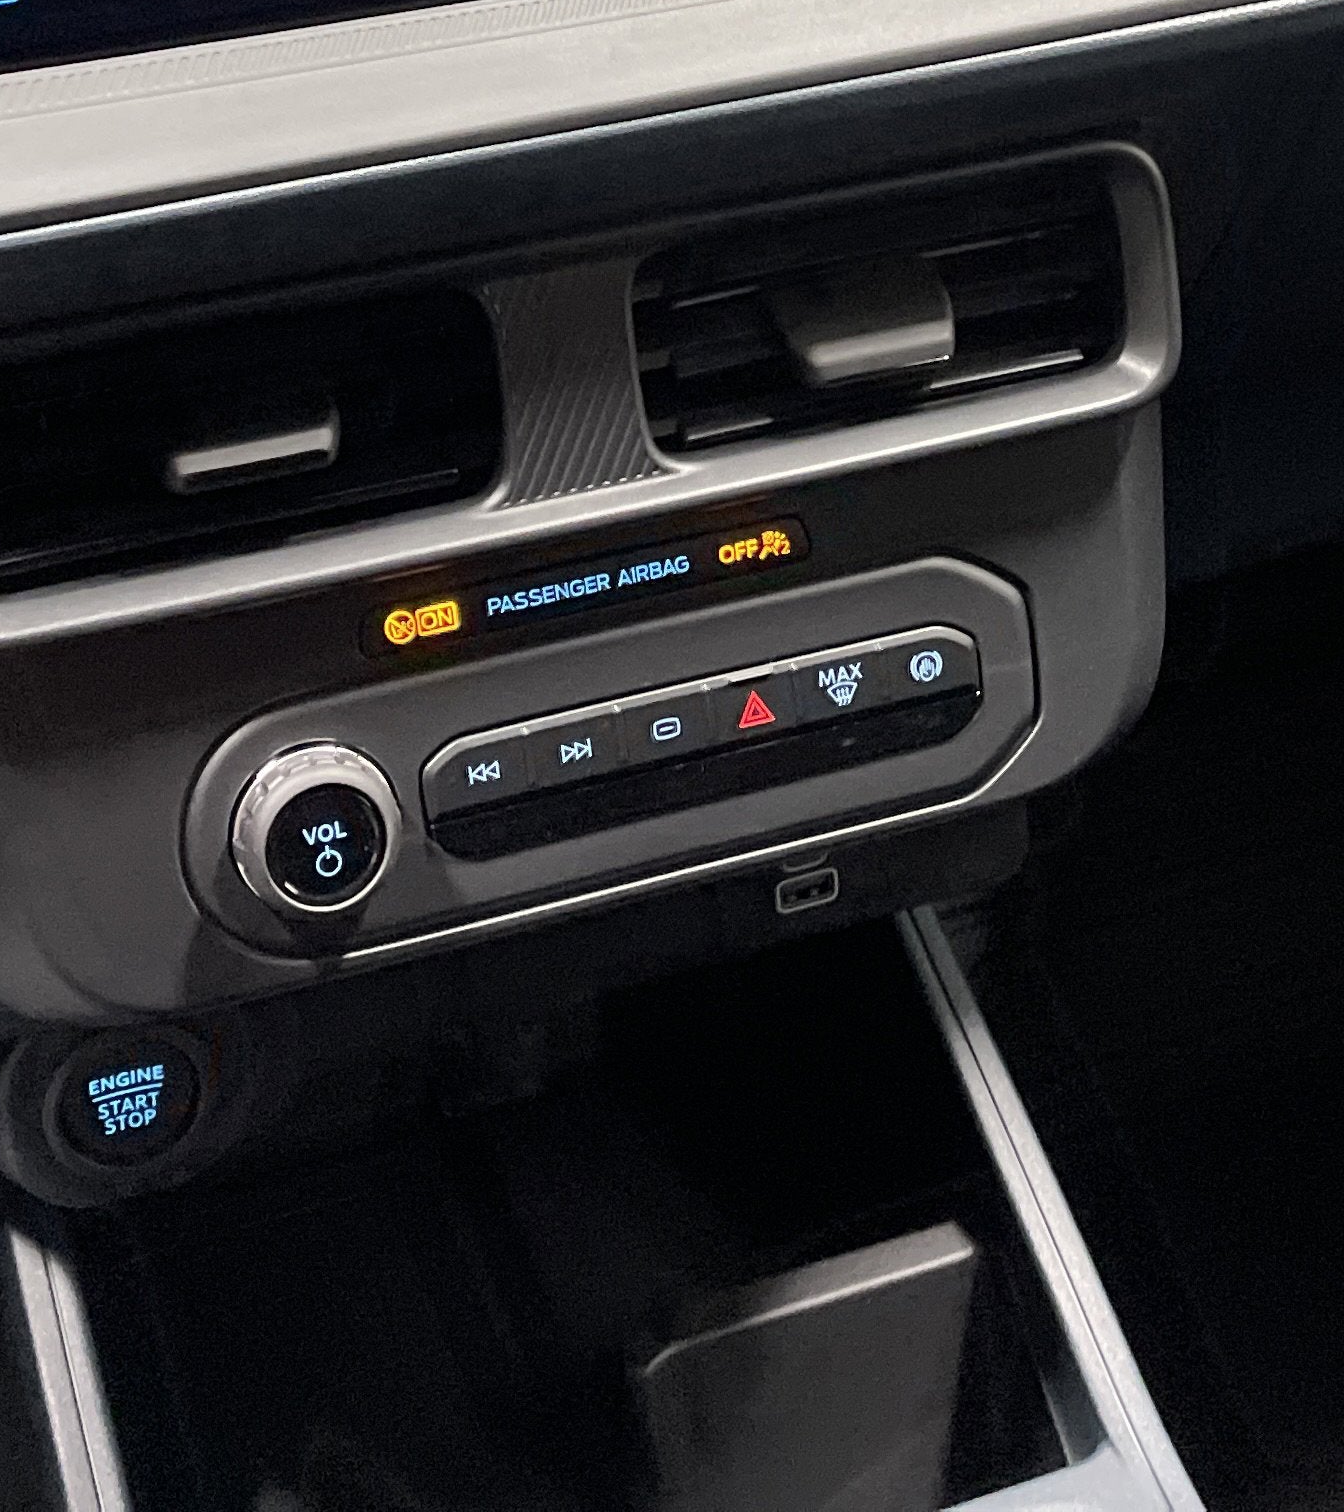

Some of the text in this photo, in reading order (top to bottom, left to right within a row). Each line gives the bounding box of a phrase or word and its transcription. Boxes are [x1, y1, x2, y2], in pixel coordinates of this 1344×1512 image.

[718, 538, 758, 564] OFF
[487, 555, 690, 616] PASSENGER AIRBAG
[420, 607, 453, 630] ON
[818, 661, 863, 688] MAX
[302, 821, 347, 845] VOL
[88, 1064, 164, 1096] ENGINE
[98, 1091, 159, 1120] START
[105, 1109, 156, 1136] STOP
